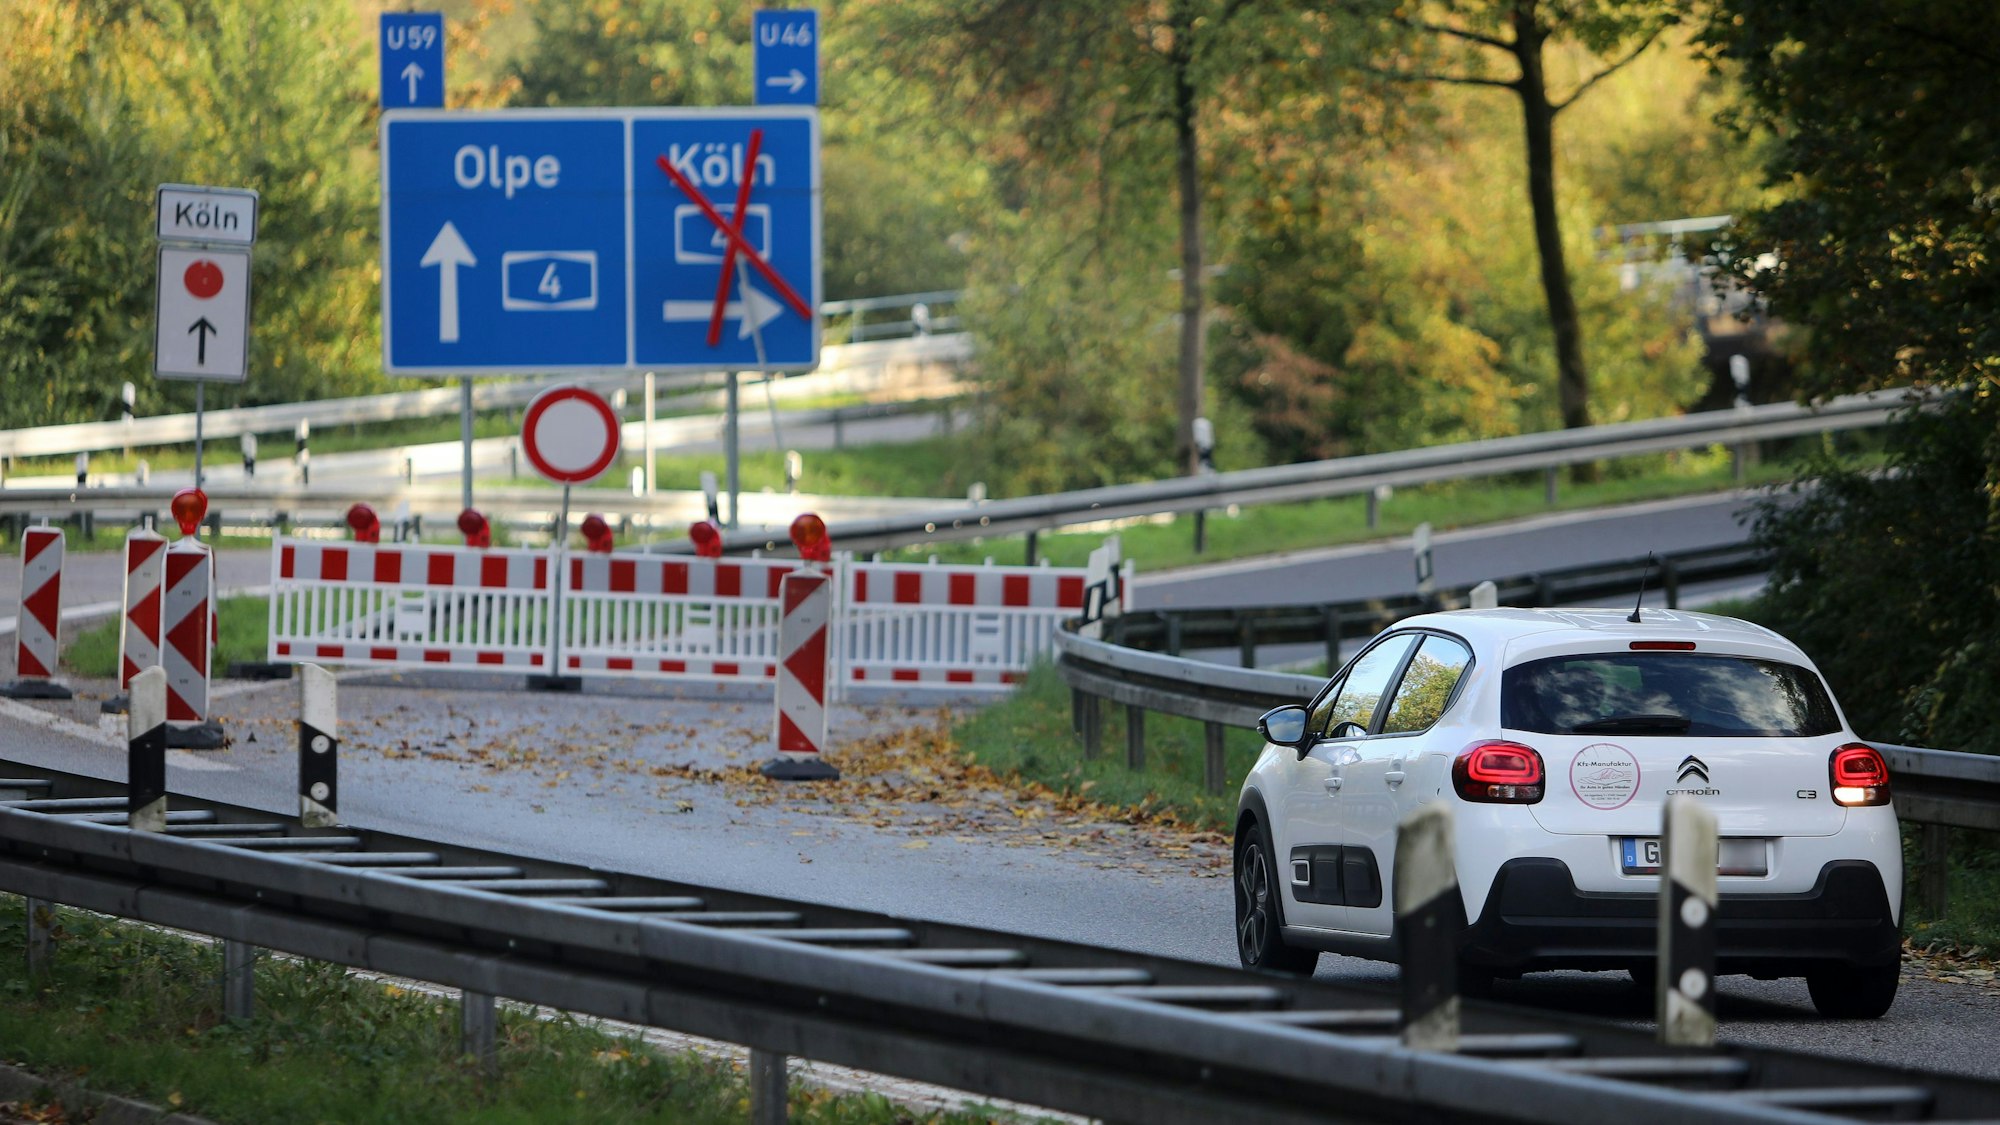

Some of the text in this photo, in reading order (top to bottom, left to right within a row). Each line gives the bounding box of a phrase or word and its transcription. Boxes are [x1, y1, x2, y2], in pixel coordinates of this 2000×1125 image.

[454, 143, 562, 200] Olpe
[668, 142, 776, 187] Köln
[175, 201, 238, 231] Köln
[538, 262, 562, 299] 4
[1666, 787, 1720, 796] CITROËN
[1796, 790, 1817, 799] C3
[1626, 855, 1633, 863] D
